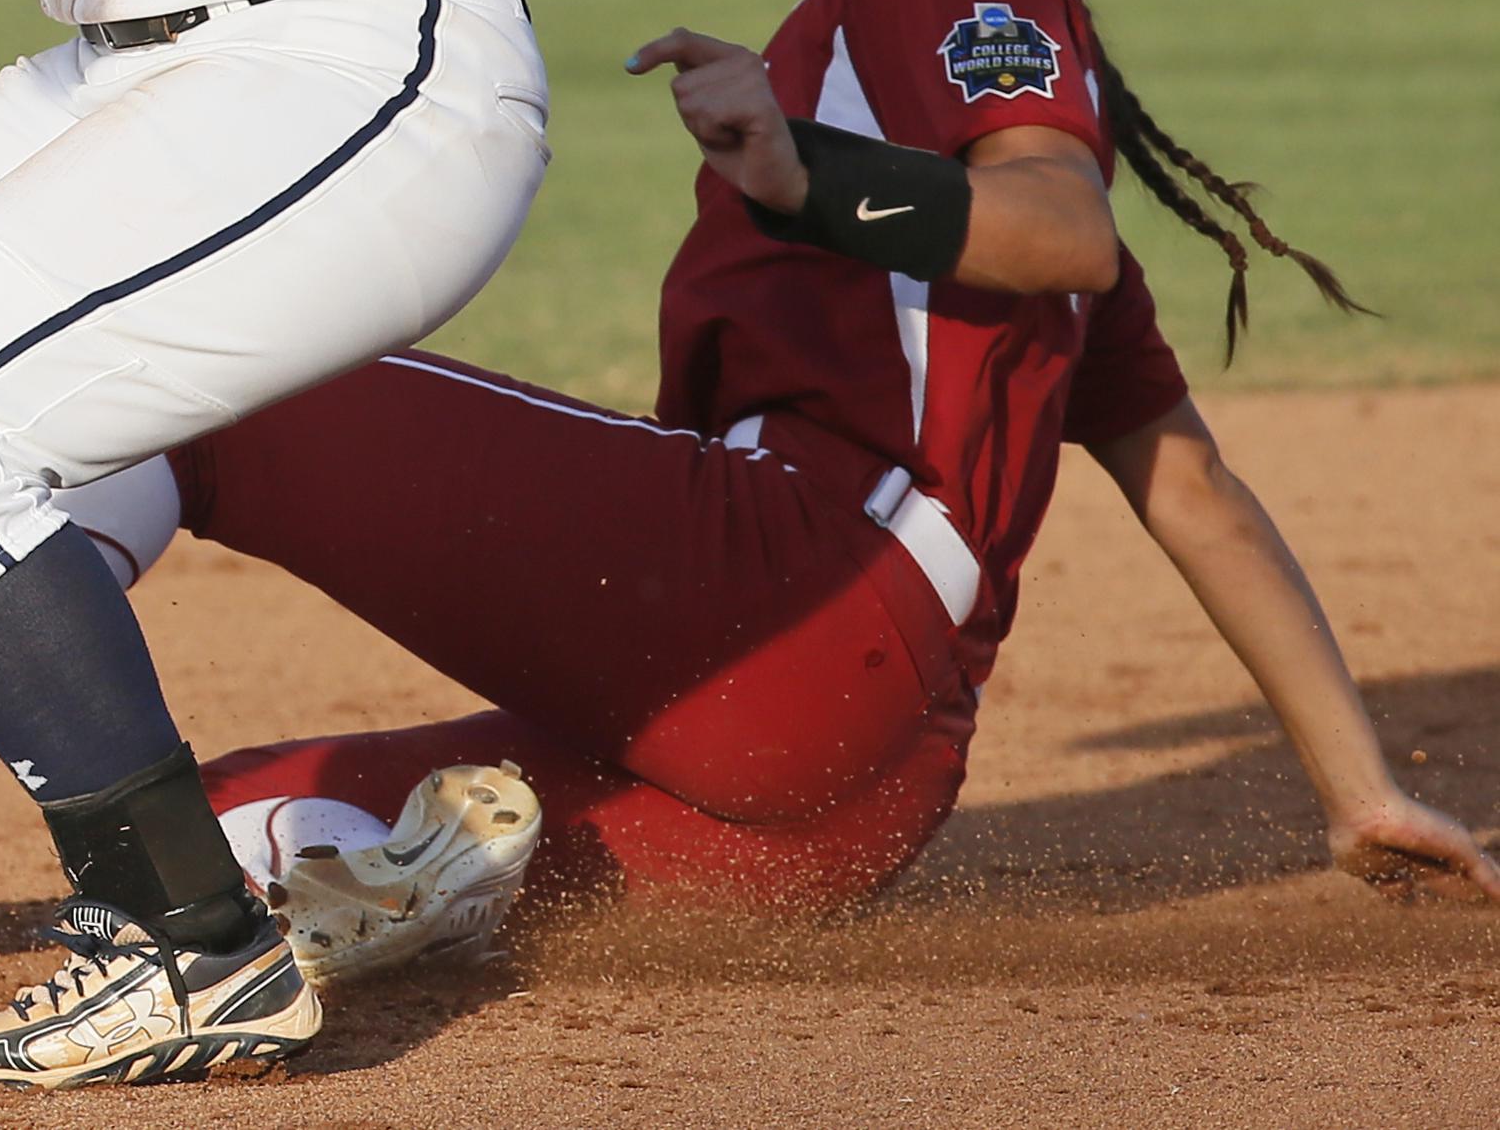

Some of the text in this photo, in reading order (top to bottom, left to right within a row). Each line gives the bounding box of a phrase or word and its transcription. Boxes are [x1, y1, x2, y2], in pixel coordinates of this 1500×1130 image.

[971, 43, 1030, 58] COLLEGE
[952, 55, 1053, 74] WORLD SERIES
